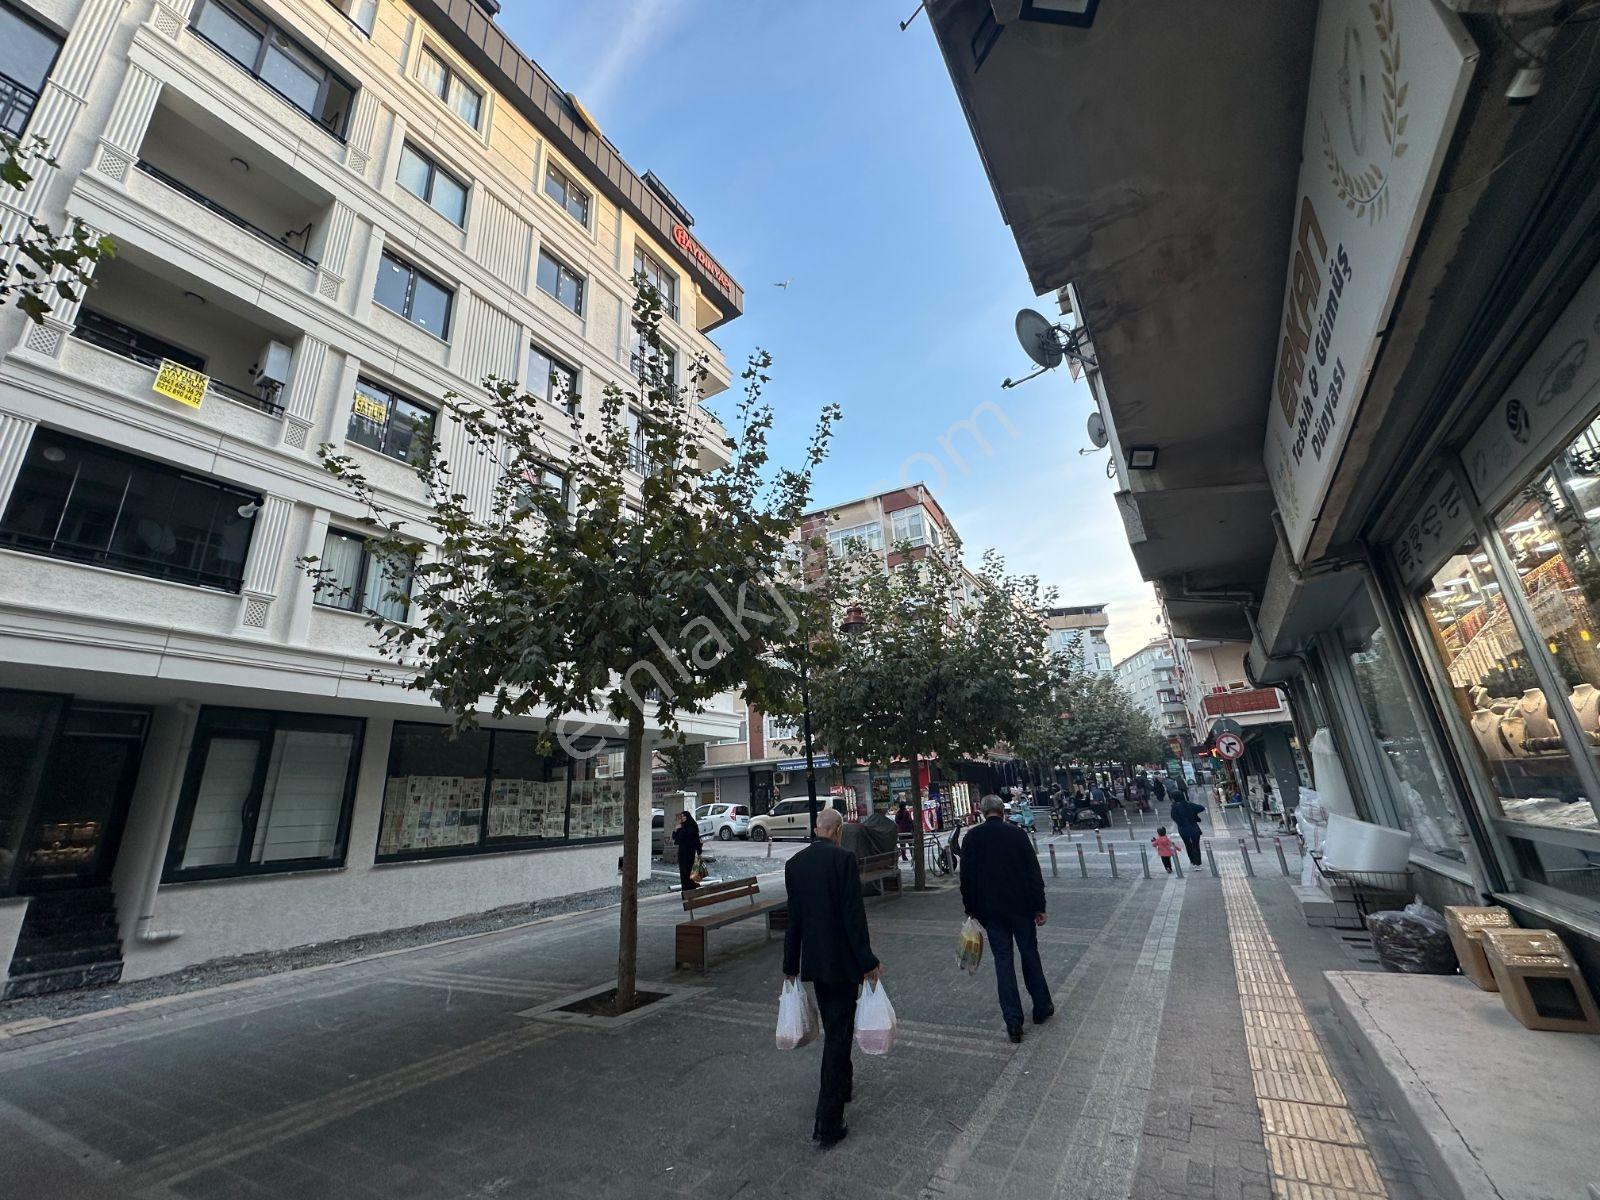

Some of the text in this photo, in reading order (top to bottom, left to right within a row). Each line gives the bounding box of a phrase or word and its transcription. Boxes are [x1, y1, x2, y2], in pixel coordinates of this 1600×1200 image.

[1277, 195, 1328, 429] ERKAN
[1291, 242, 1352, 467] Tesbih & Gümüş
[1310, 356, 1346, 463] Dünyası
